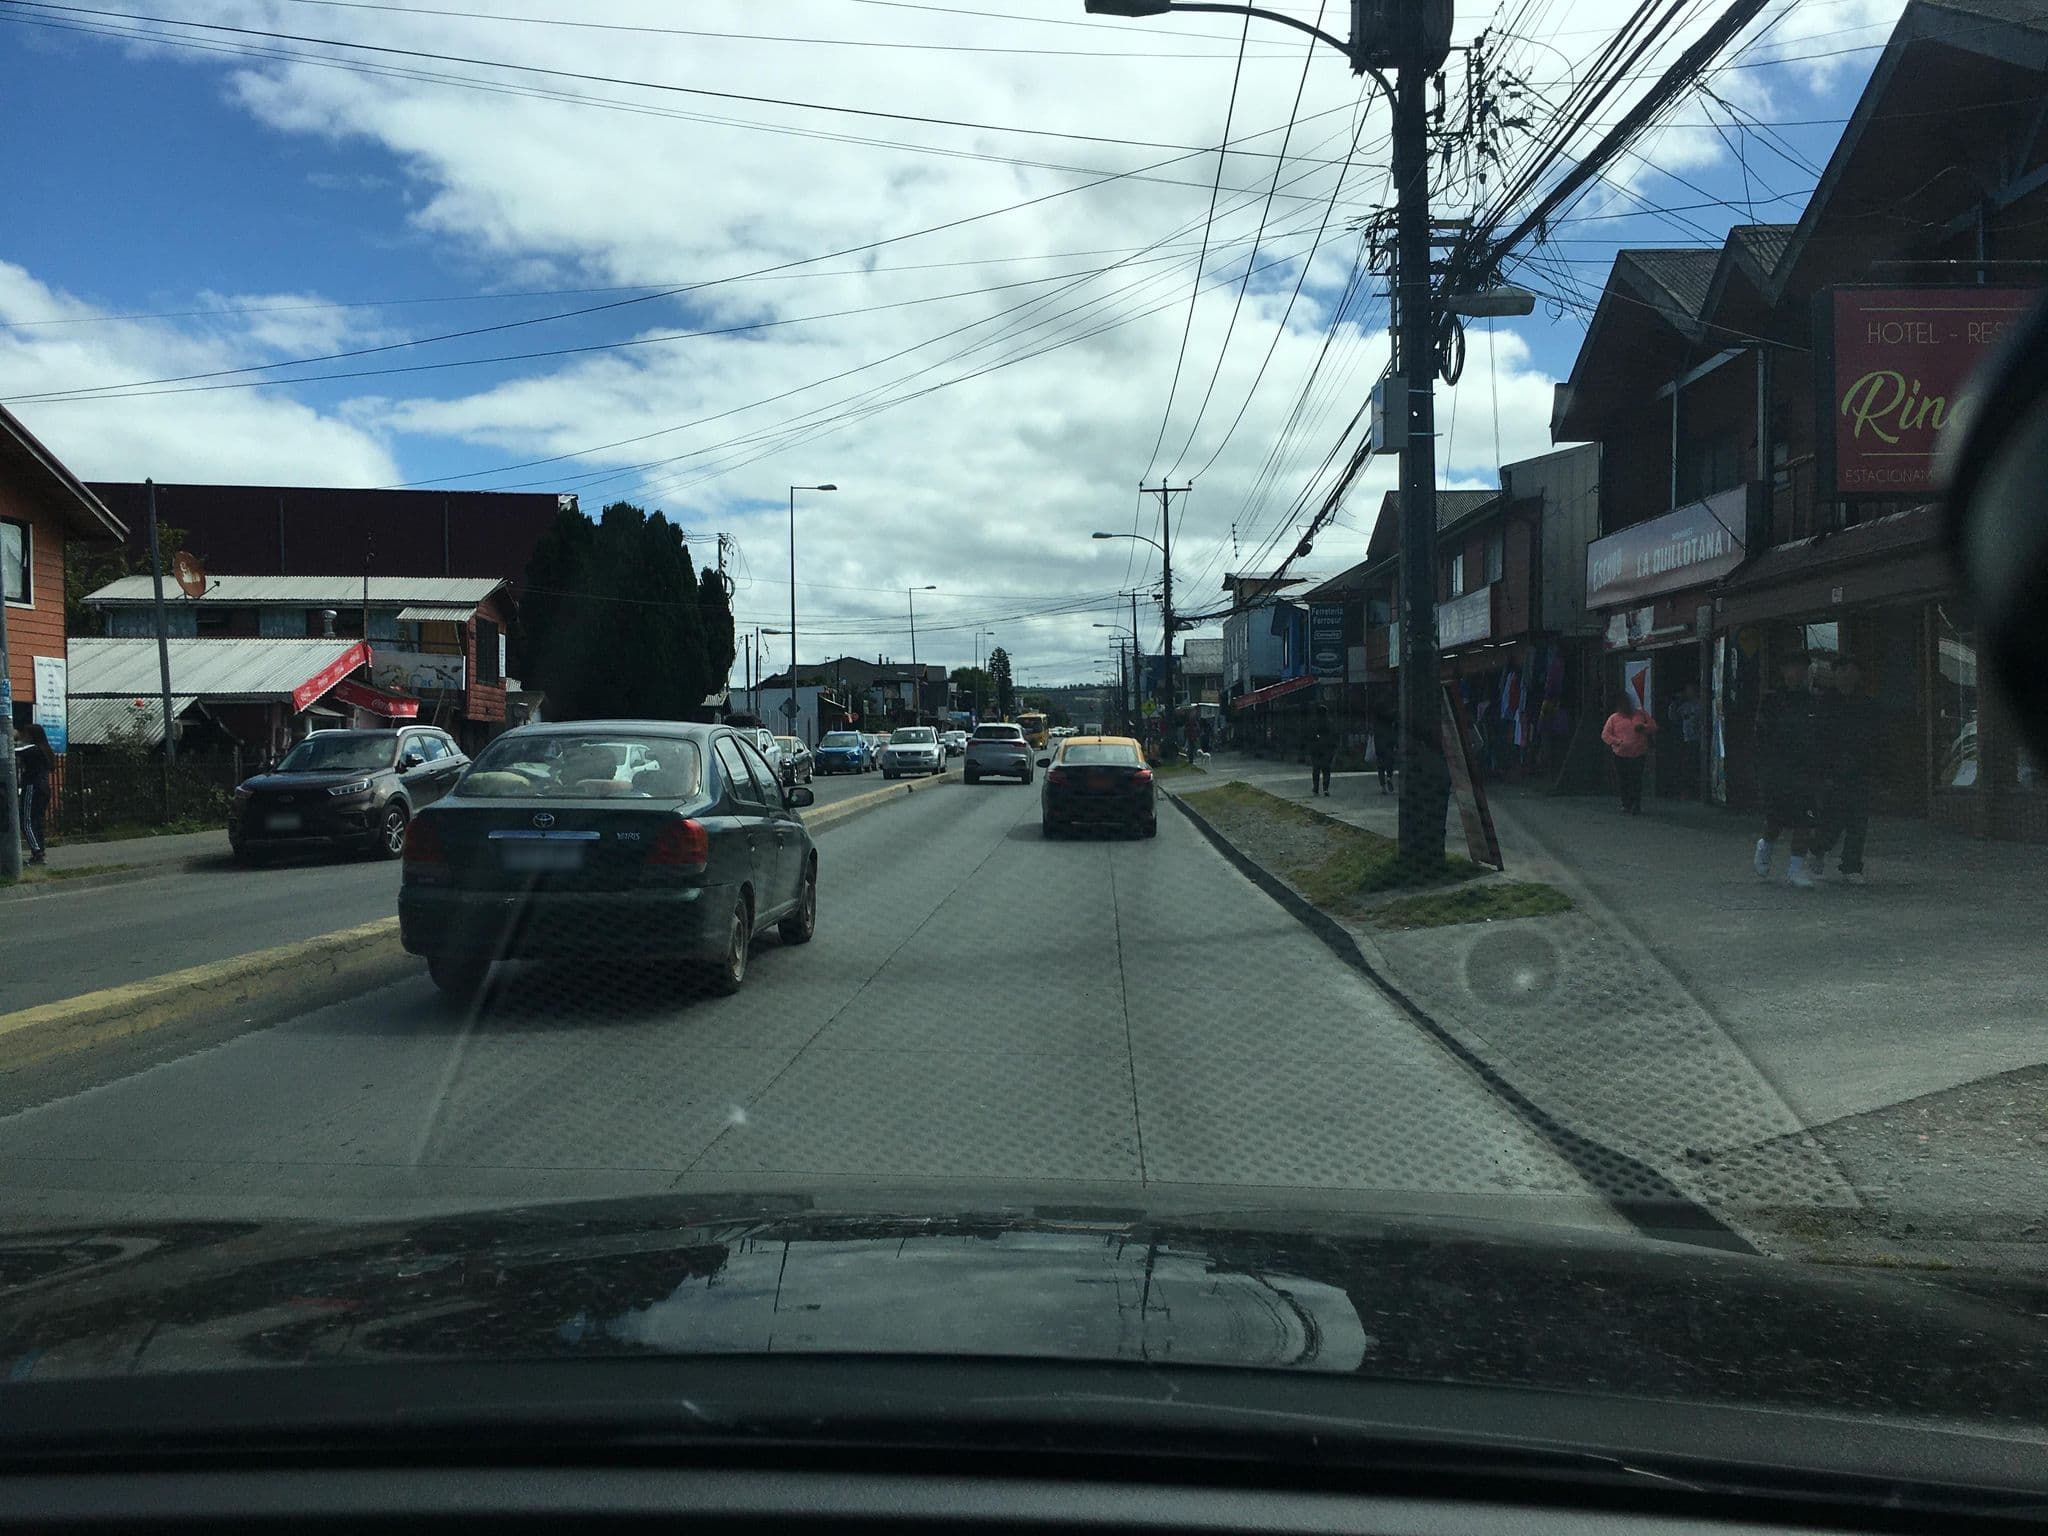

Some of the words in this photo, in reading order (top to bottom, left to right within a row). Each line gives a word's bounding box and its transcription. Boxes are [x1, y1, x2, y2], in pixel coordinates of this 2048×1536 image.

[1867, 321, 1940, 344] HOTEL
[1653, 530, 1723, 574] QUILLOTANA
[616, 832, 641, 841] YARIS
